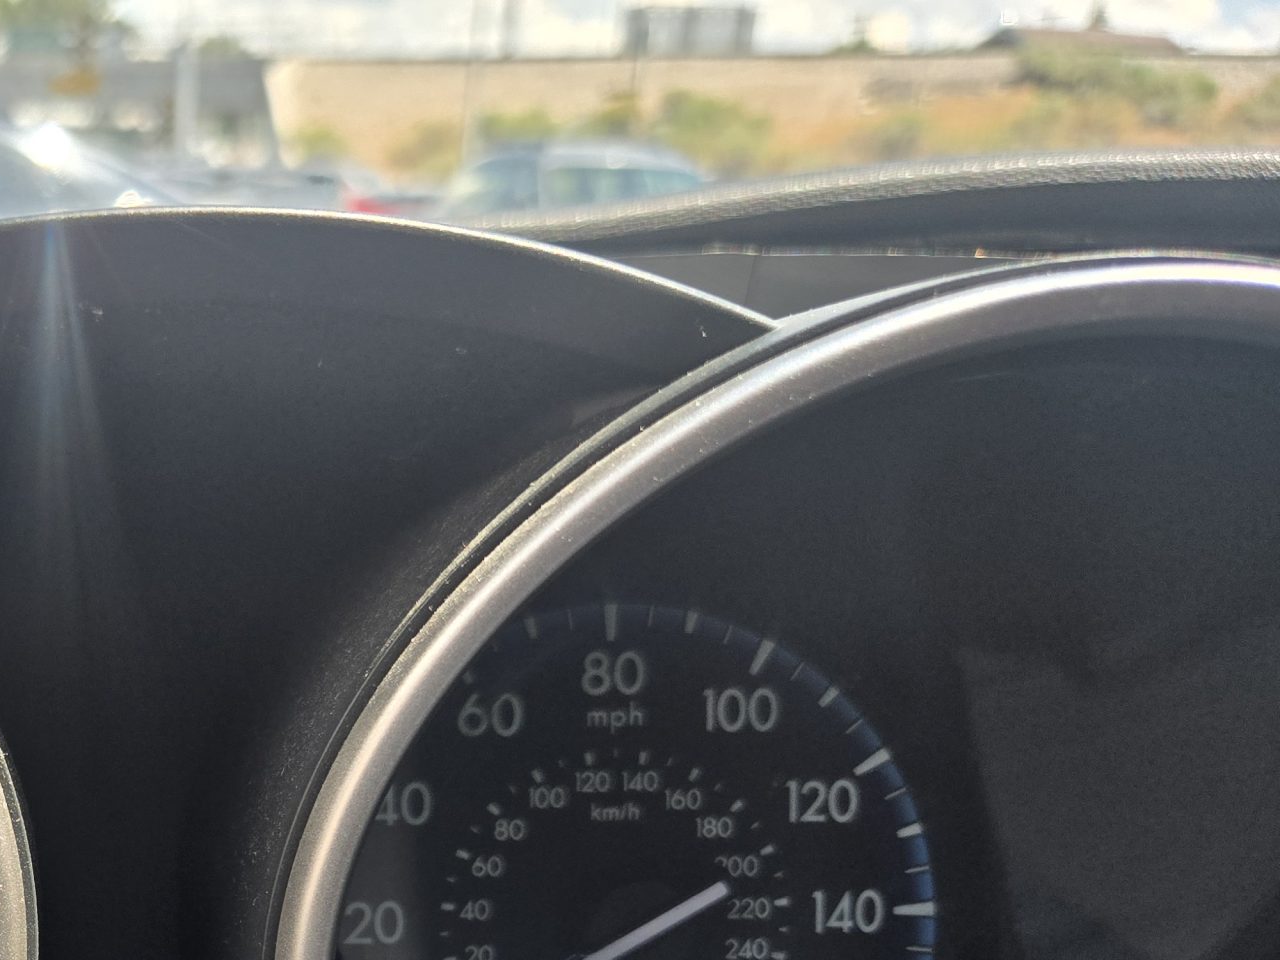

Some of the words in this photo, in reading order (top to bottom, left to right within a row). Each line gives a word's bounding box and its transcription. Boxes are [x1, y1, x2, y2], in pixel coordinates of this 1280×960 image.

[581, 651, 644, 695] 80
[458, 694, 523, 737] 60
[587, 701, 644, 734] mph
[703, 688, 777, 732] 100
[575, 771, 610, 792] 120
[622, 771, 658, 792] 140
[375, 781, 432, 826] 40
[529, 788, 565, 808] 100
[665, 789, 700, 810] 160
[786, 780, 858, 823] 120
[591, 804, 640, 821] km/h
[494, 818, 525, 841] 80
[696, 817, 733, 838] 180
[472, 856, 502, 877] 60
[460, 900, 489, 920] 40
[728, 898, 769, 919] 220
[812, 889, 884, 933] 140
[344, 901, 403, 945] 20
[724, 938, 769, 960] 240
